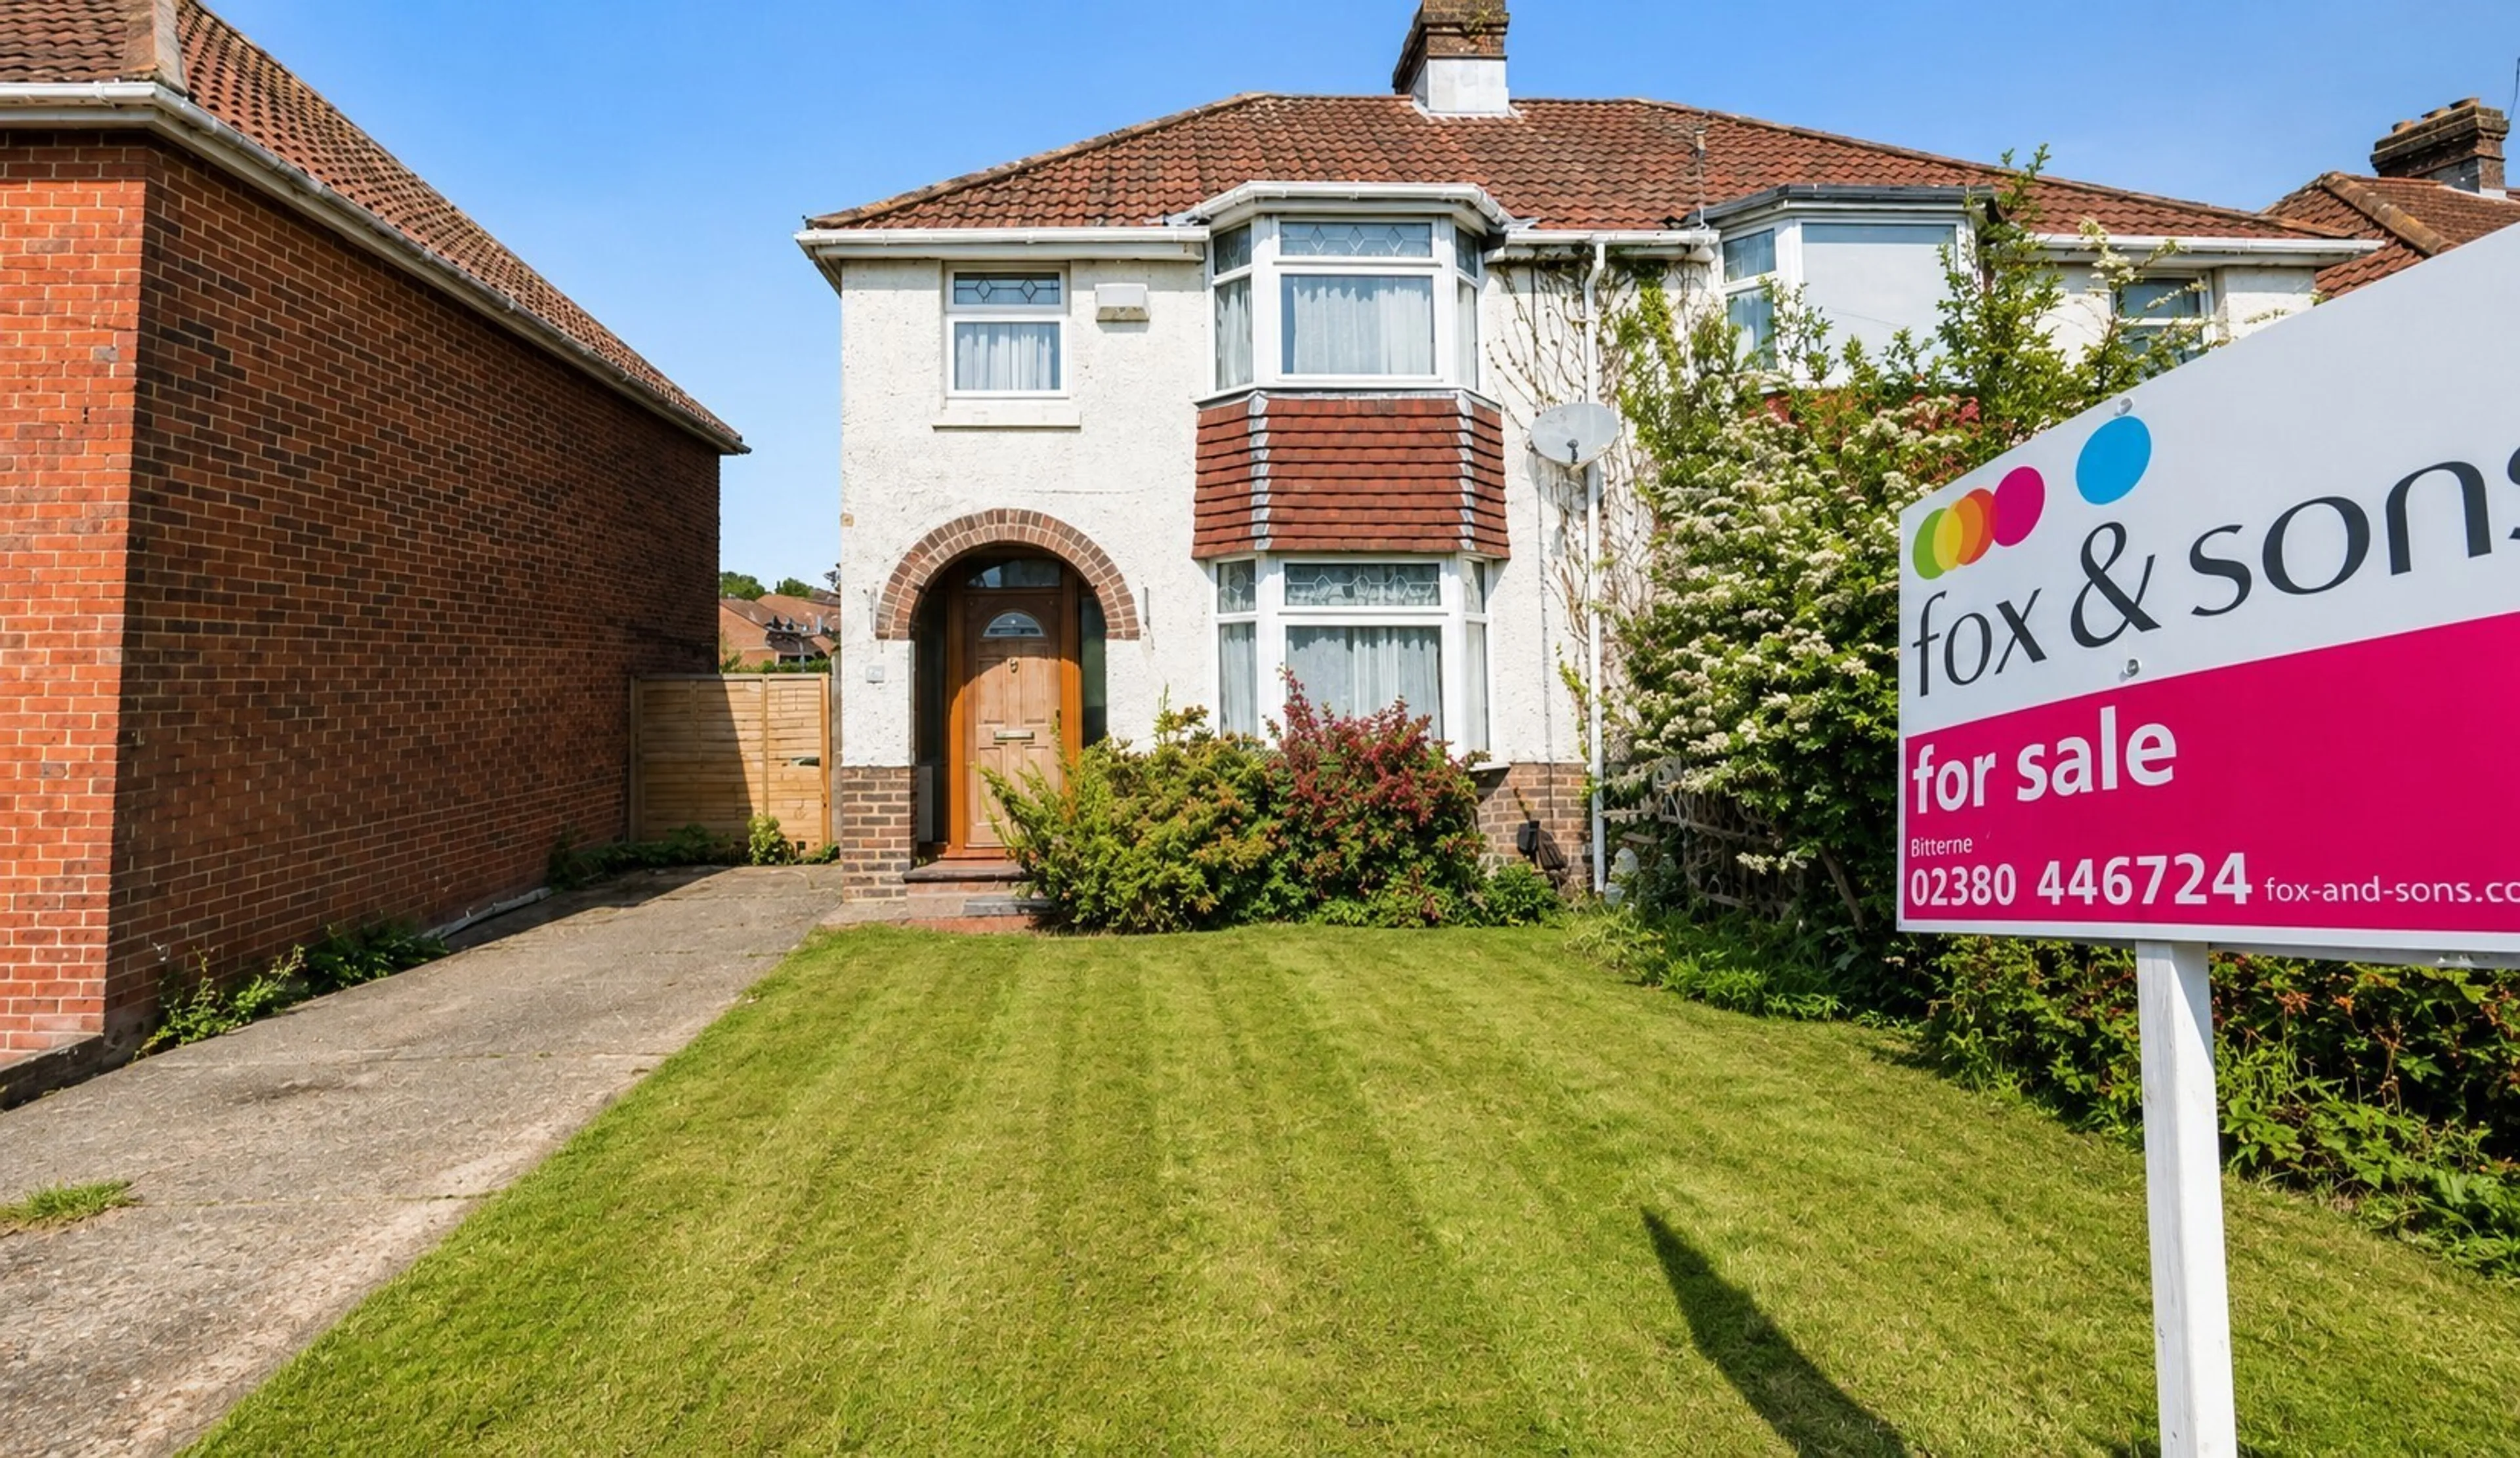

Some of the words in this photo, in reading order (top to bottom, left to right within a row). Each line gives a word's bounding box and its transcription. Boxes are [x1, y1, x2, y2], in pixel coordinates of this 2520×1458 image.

[1912, 588, 2048, 698] fox
[2070, 521, 2162, 649] &
[2189, 447, 2520, 617] son
[1912, 743, 1996, 814] for
[2017, 705, 2177, 802] sale
[1910, 835, 1973, 858] Bitterne
[1910, 863, 2017, 907] 02380
[2036, 852, 2253, 906] 446724
[2263, 875, 2520, 904] fox-and-sons.co
